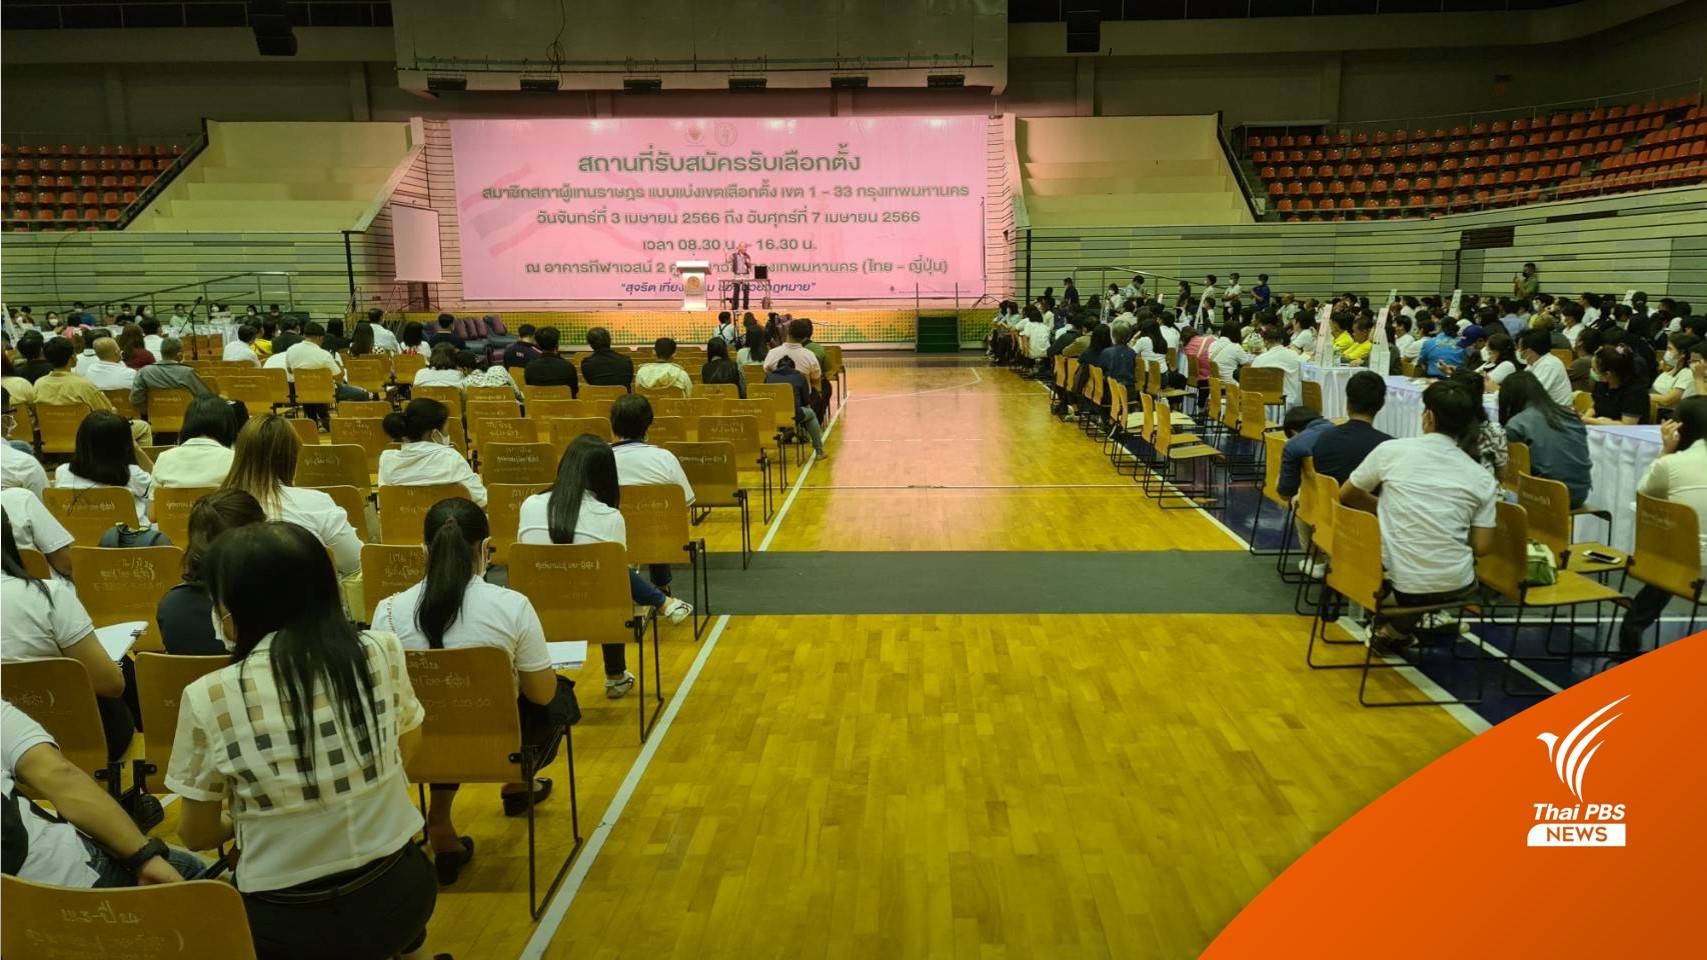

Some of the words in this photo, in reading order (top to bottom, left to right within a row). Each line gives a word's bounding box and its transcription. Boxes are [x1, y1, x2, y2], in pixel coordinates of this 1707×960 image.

[578, 143, 861, 173] สถานที่รับสมัครรับเลือกตั้ง
[482, 183, 646, 202] สมาชิกสภาผู้แทนราษฎร
[649, 180, 777, 200] แบบแบ่งเขตเลือกตั้ง
[781, 186, 803, 199] เขต
[808, 186, 817, 198] 1
[834, 186, 854, 198] 33
[857, 186, 970, 202] กรุงเทพมหานคร
[536, 207, 607, 224] วันจันทร์ที่
[611, 213, 622, 224] 3
[624, 213, 679, 224] เมษายน
[682, 212, 720, 224] 2566
[725, 209, 744, 224] ถึง
[747, 207, 808, 228] วันศุกร์ที่
[811, 212, 822, 224] 7
[825, 213, 879, 224] เมษายน
[882, 211, 921, 224] 2566
[642, 240, 675, 252] เวลา
[678, 239, 721, 252] 08.30
[757, 239, 799, 251] 16.30
[801, 240, 818, 252] น.
[525, 263, 540, 273] ณ
[543, 259, 652, 273] อาคารกีฬาเวสน์
[656, 263, 666, 273] 2
[862, 258, 893, 274] (ไทย
